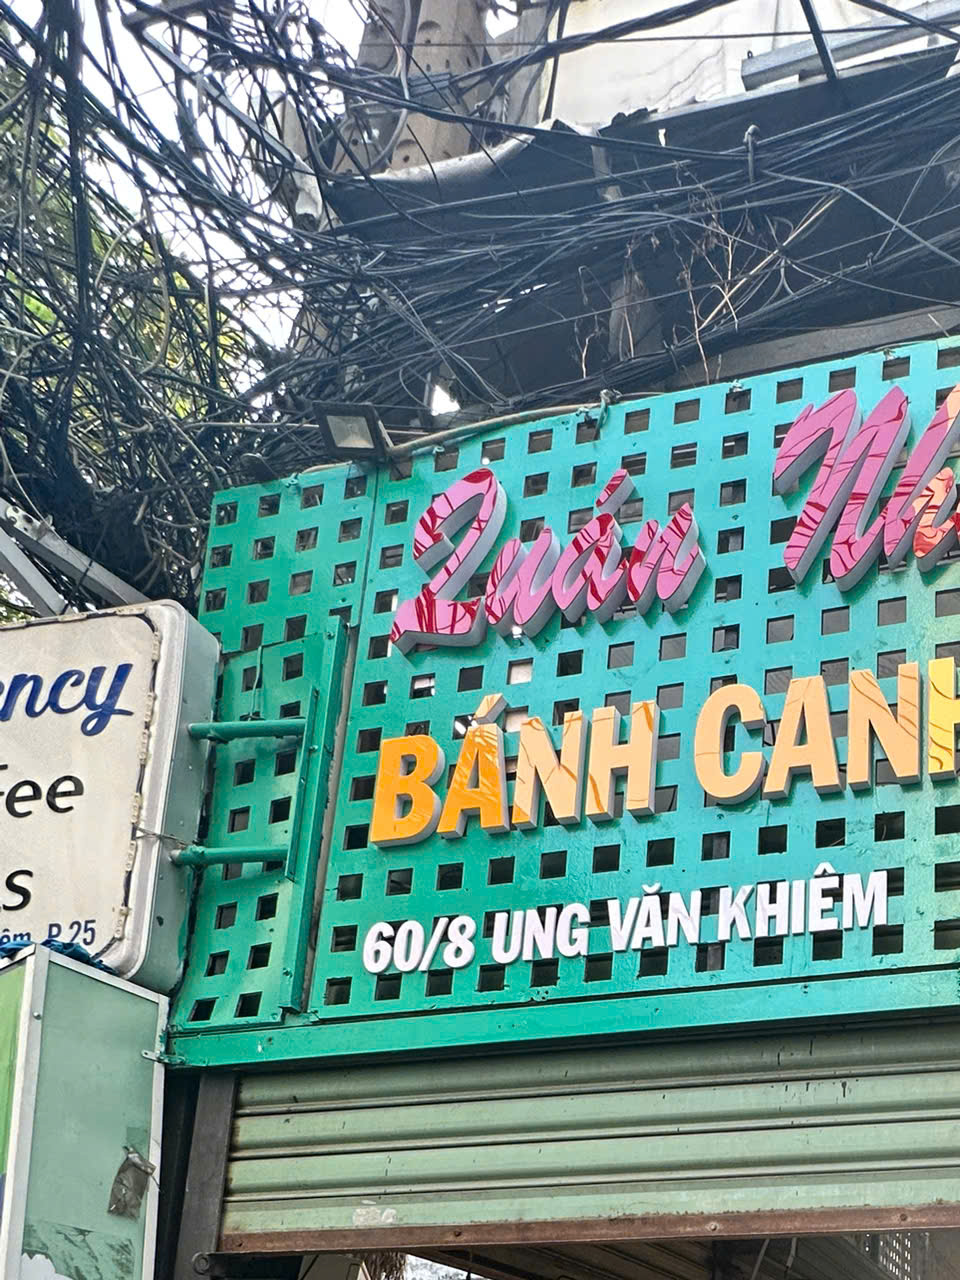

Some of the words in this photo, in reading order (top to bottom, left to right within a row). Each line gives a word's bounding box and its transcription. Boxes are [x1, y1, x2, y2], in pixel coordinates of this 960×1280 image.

[391, 468, 704, 653] Quán
[369, 694, 662, 848] BÁNH
[362, 914, 477, 975] 60/8
[491, 902, 592, 964] UNG
[608, 880, 703, 952] VĂN
[717, 861, 888, 941] KHIÊM
